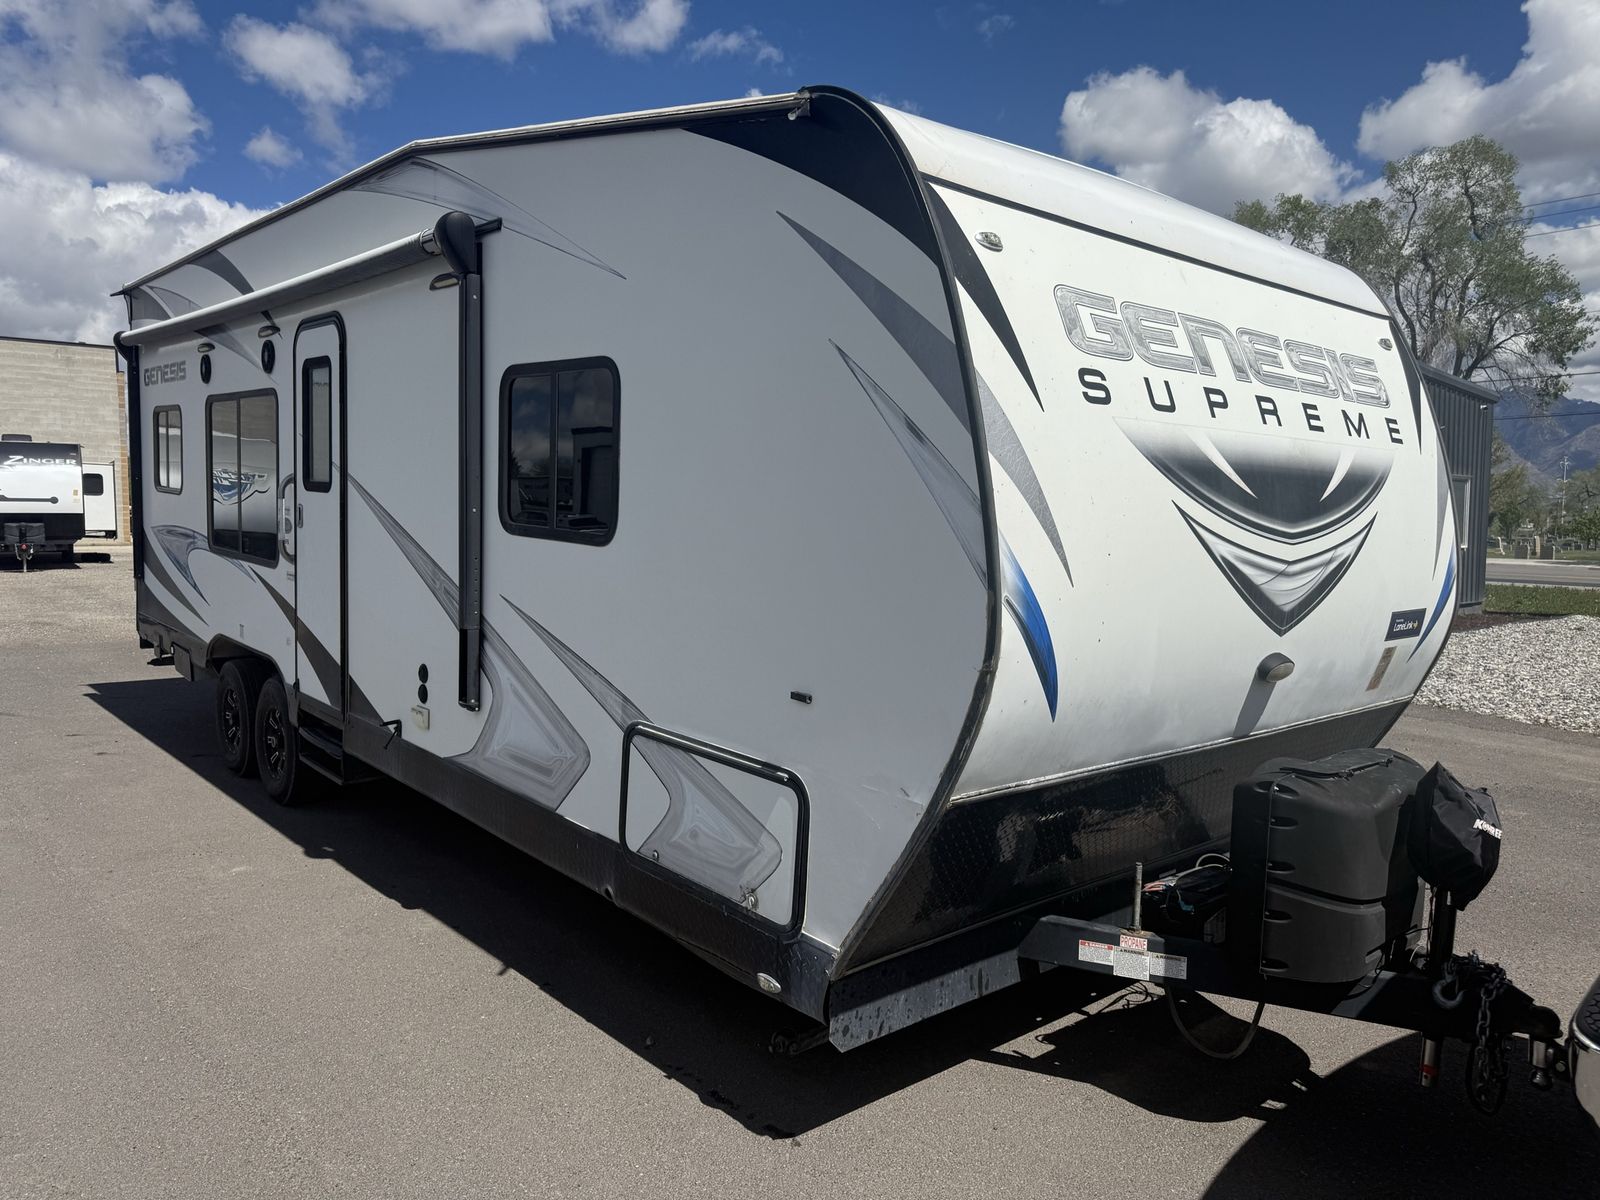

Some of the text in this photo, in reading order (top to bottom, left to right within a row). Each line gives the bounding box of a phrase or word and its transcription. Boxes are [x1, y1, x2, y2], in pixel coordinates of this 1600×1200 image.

[1053, 284, 1391, 409] GENESIS
[144, 360, 186, 387] GENESIS
[1078, 368, 1404, 445] SUPREME
[3, 455, 77, 465] ZINGER
[1121, 936, 1147, 950] PROPANE
